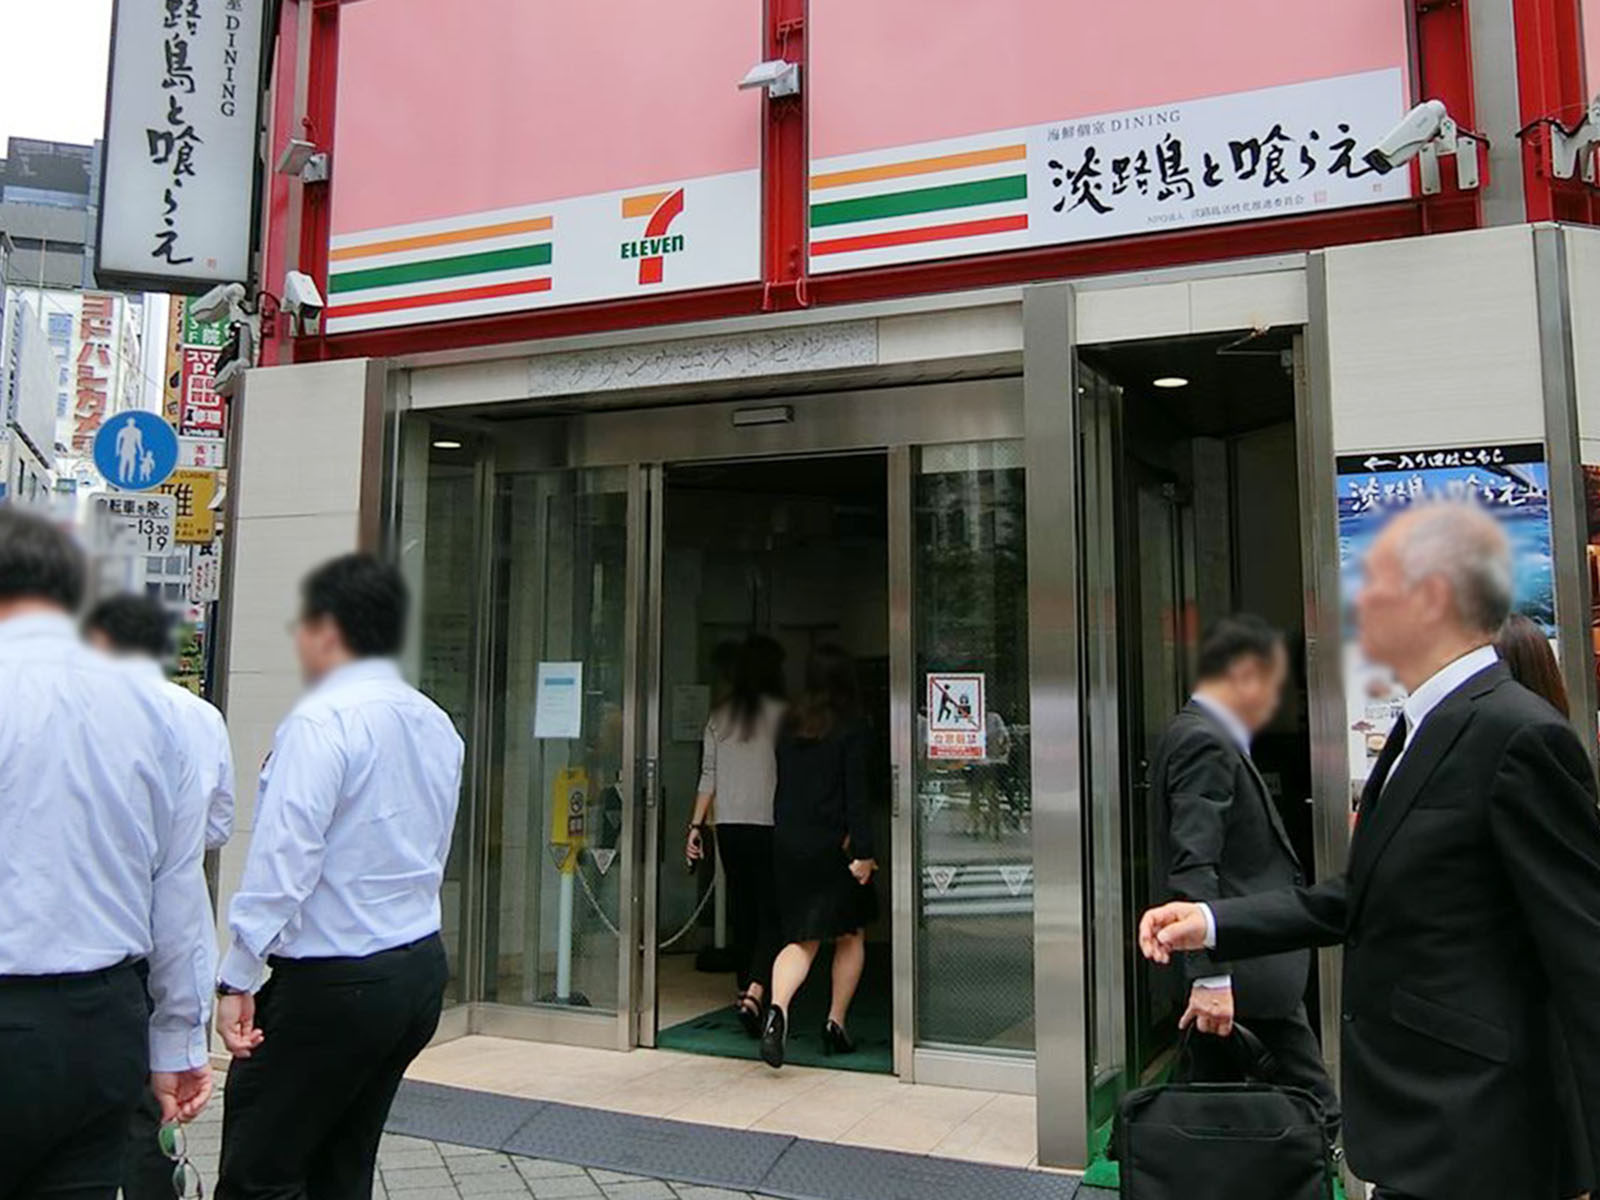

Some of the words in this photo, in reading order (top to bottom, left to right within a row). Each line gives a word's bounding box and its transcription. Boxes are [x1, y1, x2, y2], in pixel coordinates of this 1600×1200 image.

[220, 15, 240, 117] DINING
[1111, 110, 1181, 132] DINING
[146, 536, 168, 552] 19
